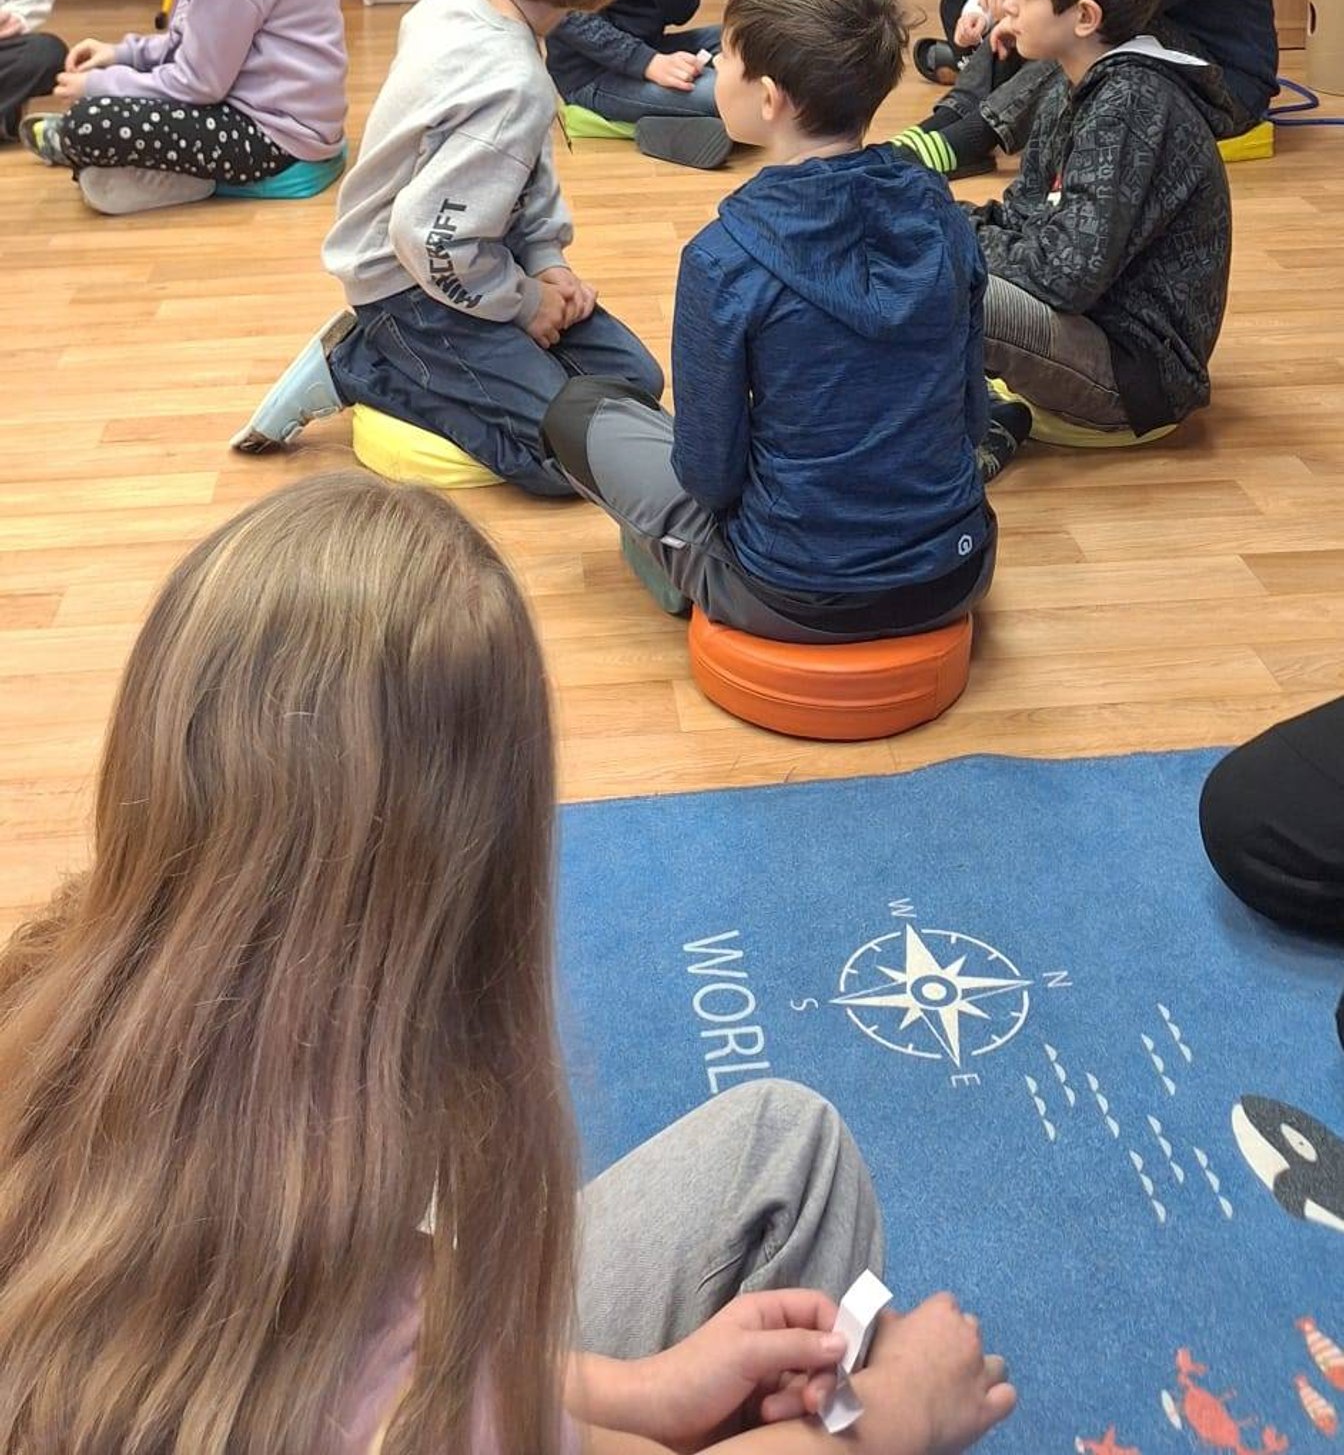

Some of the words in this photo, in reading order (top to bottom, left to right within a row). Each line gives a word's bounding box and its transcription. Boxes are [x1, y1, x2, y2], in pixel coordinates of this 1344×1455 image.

[887, 897, 917, 918] W
[1042, 970, 1073, 988] N
[682, 929, 770, 1093] WORL
[790, 997, 819, 1012] S
[951, 1072, 982, 1089] E
